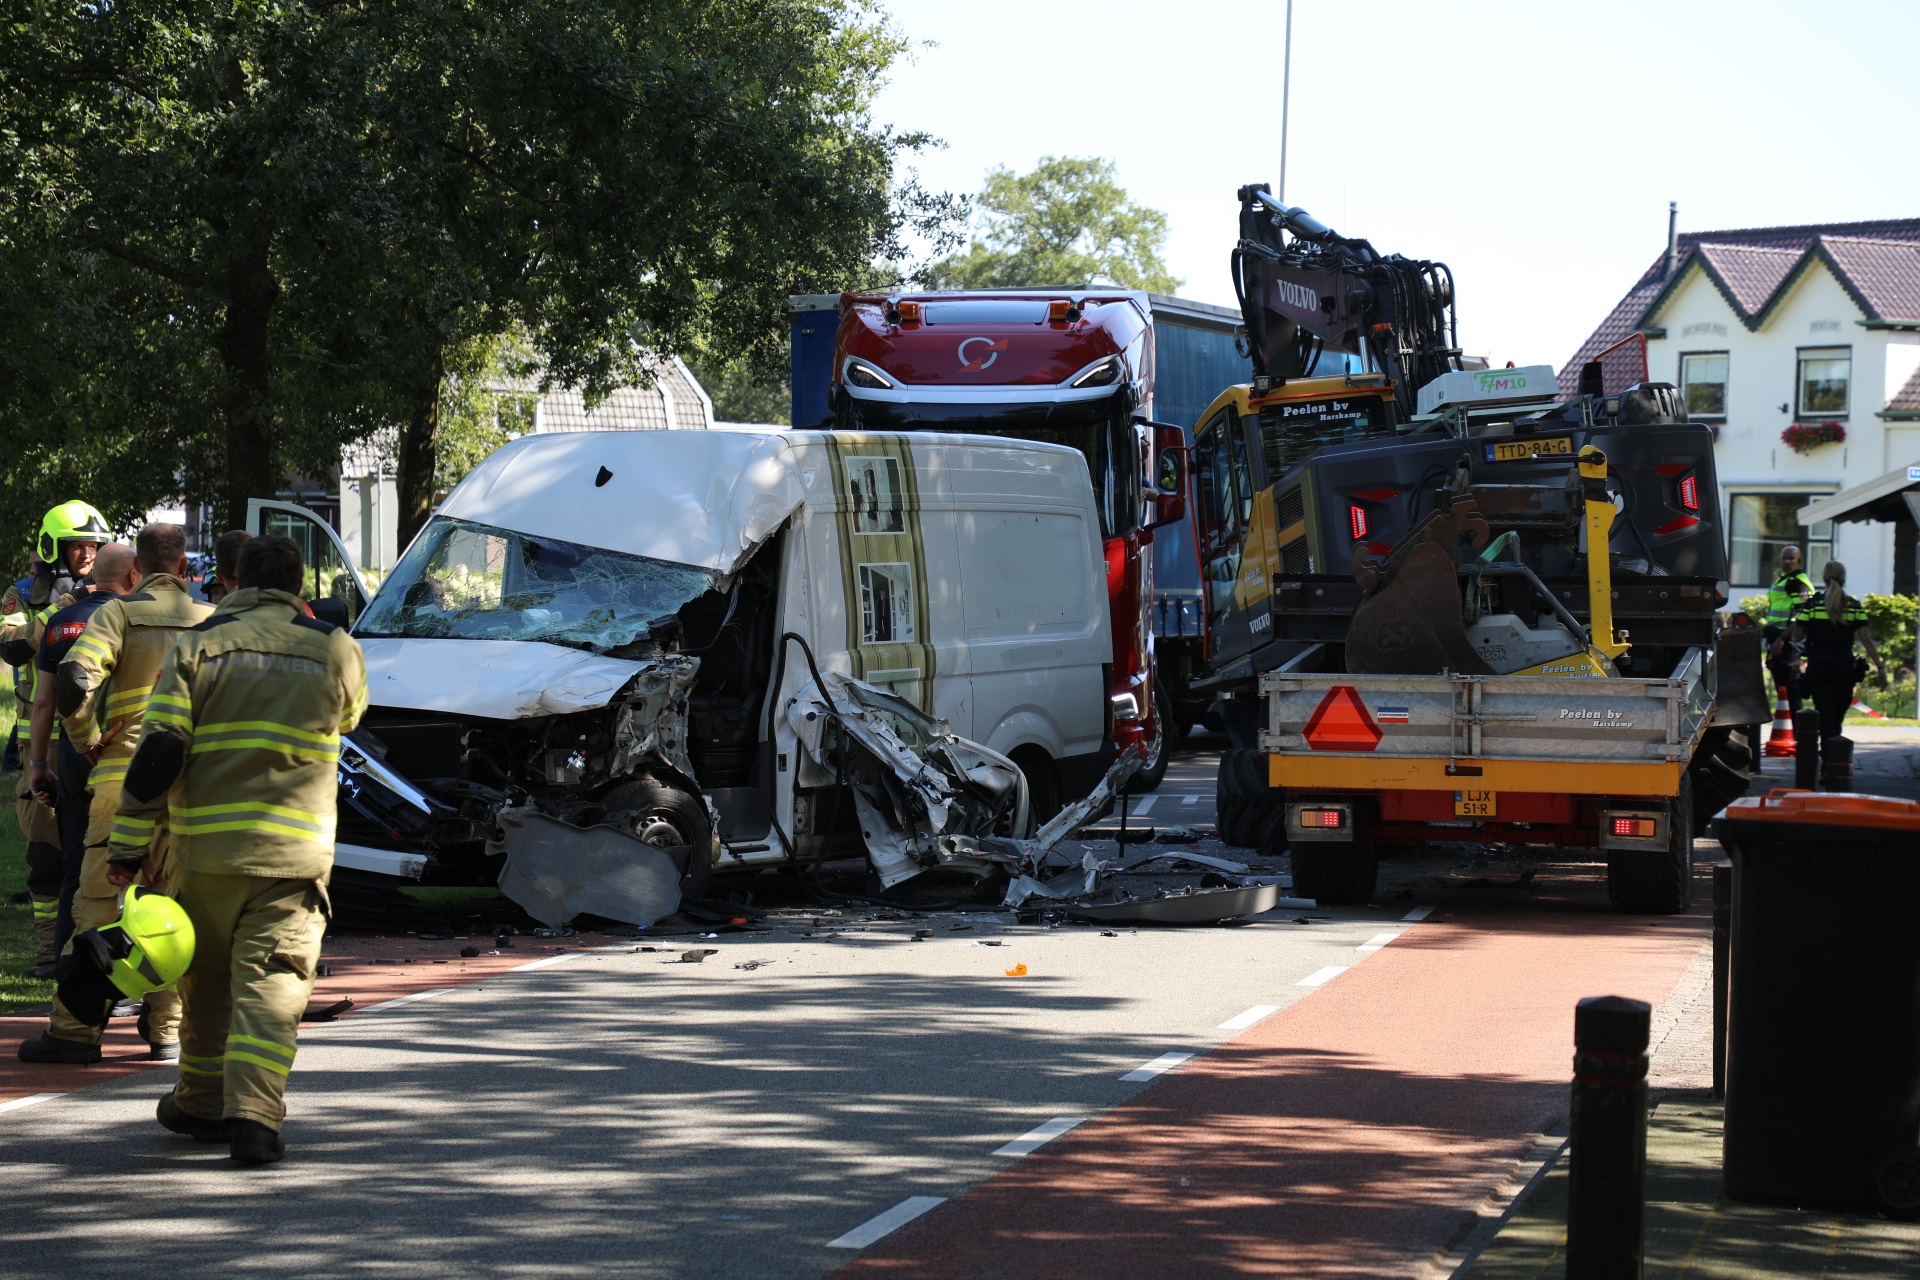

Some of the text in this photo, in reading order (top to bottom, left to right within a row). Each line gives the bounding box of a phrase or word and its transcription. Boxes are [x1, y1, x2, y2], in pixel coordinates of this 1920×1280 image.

[1276, 278, 1317, 312] VOLVO
[1282, 401, 1349, 417] Peelen bv
[1319, 412, 1362, 421] Harskamp
[1498, 440, 1567, 458] TTD-84-G
[1248, 612, 1271, 634] VOLVO
[1541, 663, 1593, 674] Peelen bv
[1559, 708, 1623, 719] Peelen bv
[1592, 720, 1633, 728] Harskamp
[1467, 791, 1491, 802] LJX
[1463, 803, 1488, 814] 51-R
